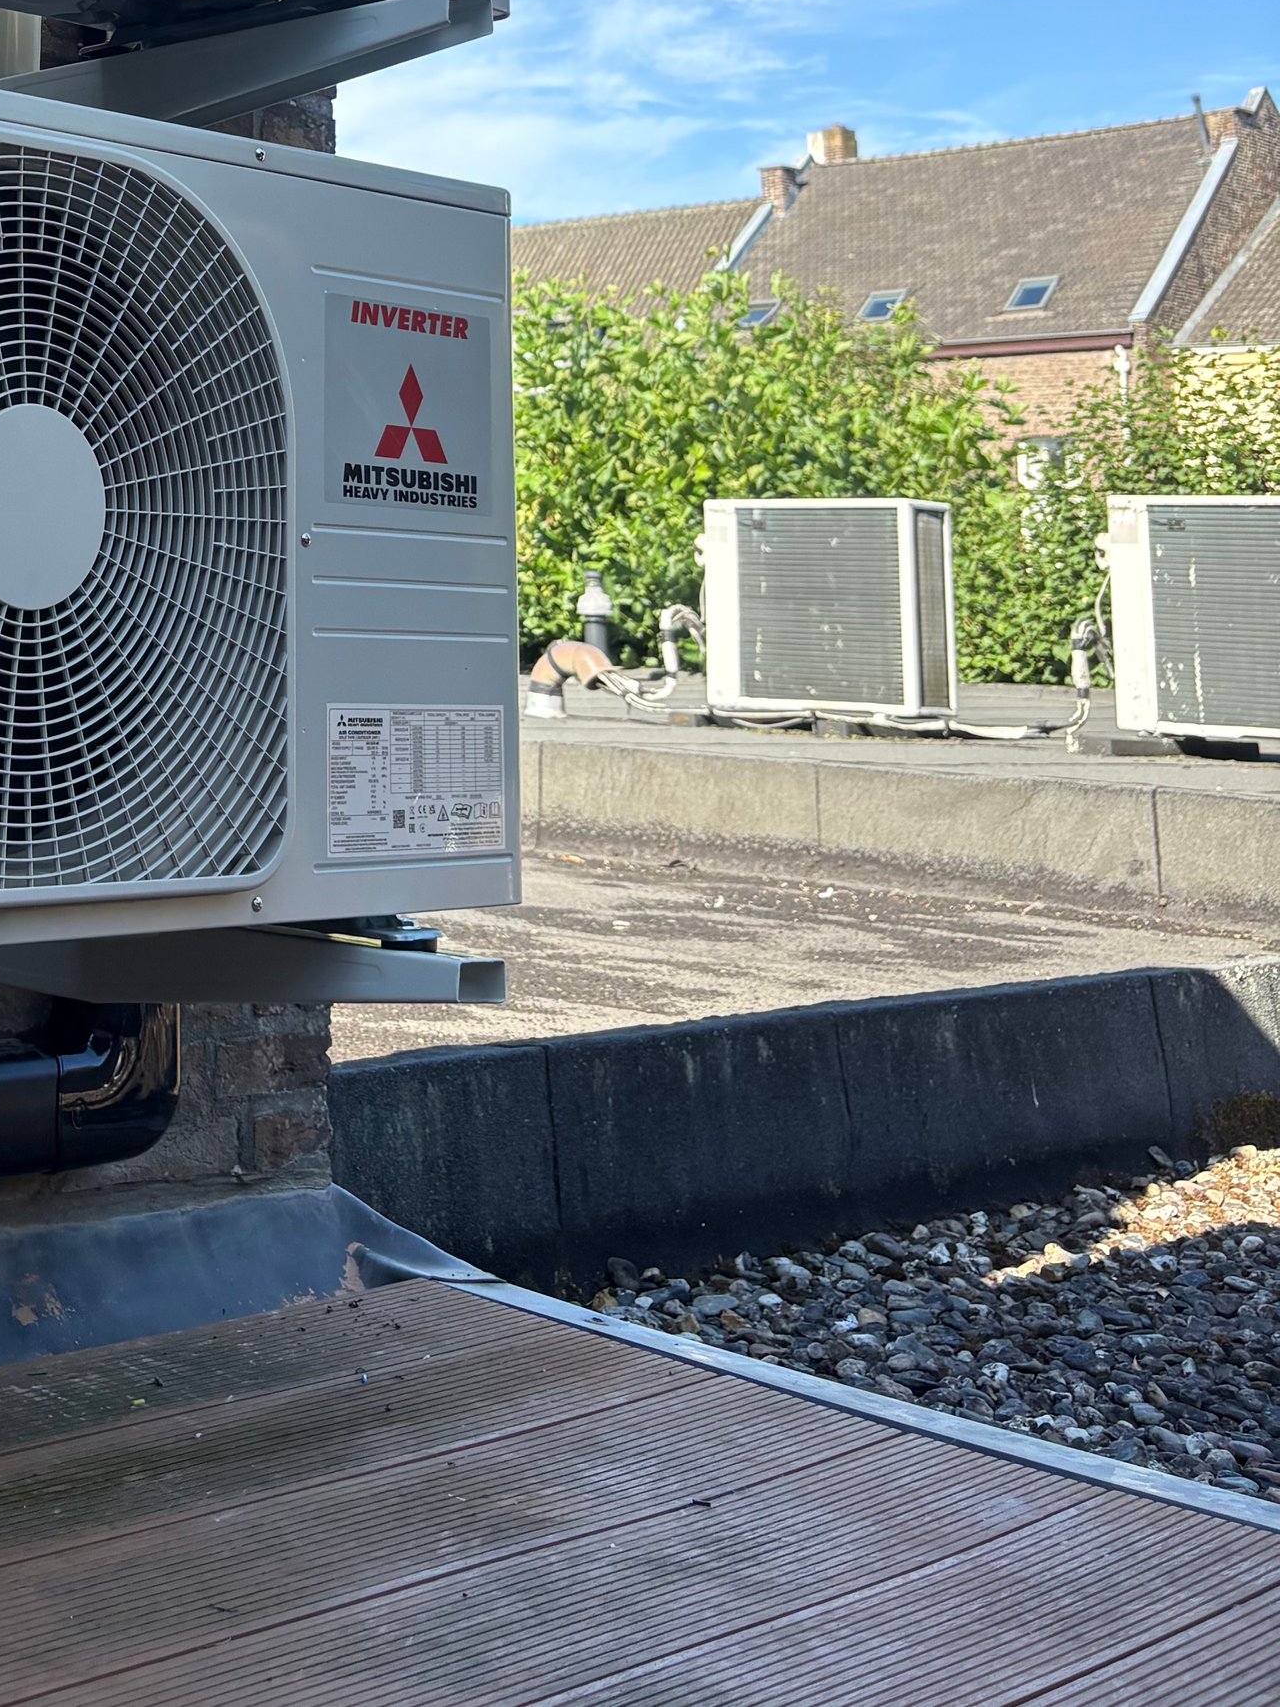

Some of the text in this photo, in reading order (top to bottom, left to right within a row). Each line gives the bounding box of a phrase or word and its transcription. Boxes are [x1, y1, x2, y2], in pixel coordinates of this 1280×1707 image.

[351, 301, 468, 339] INVERTER
[343, 463, 477, 494] MITSUBISHI
[343, 485, 477, 509] HEAVY INDUSTRIES
